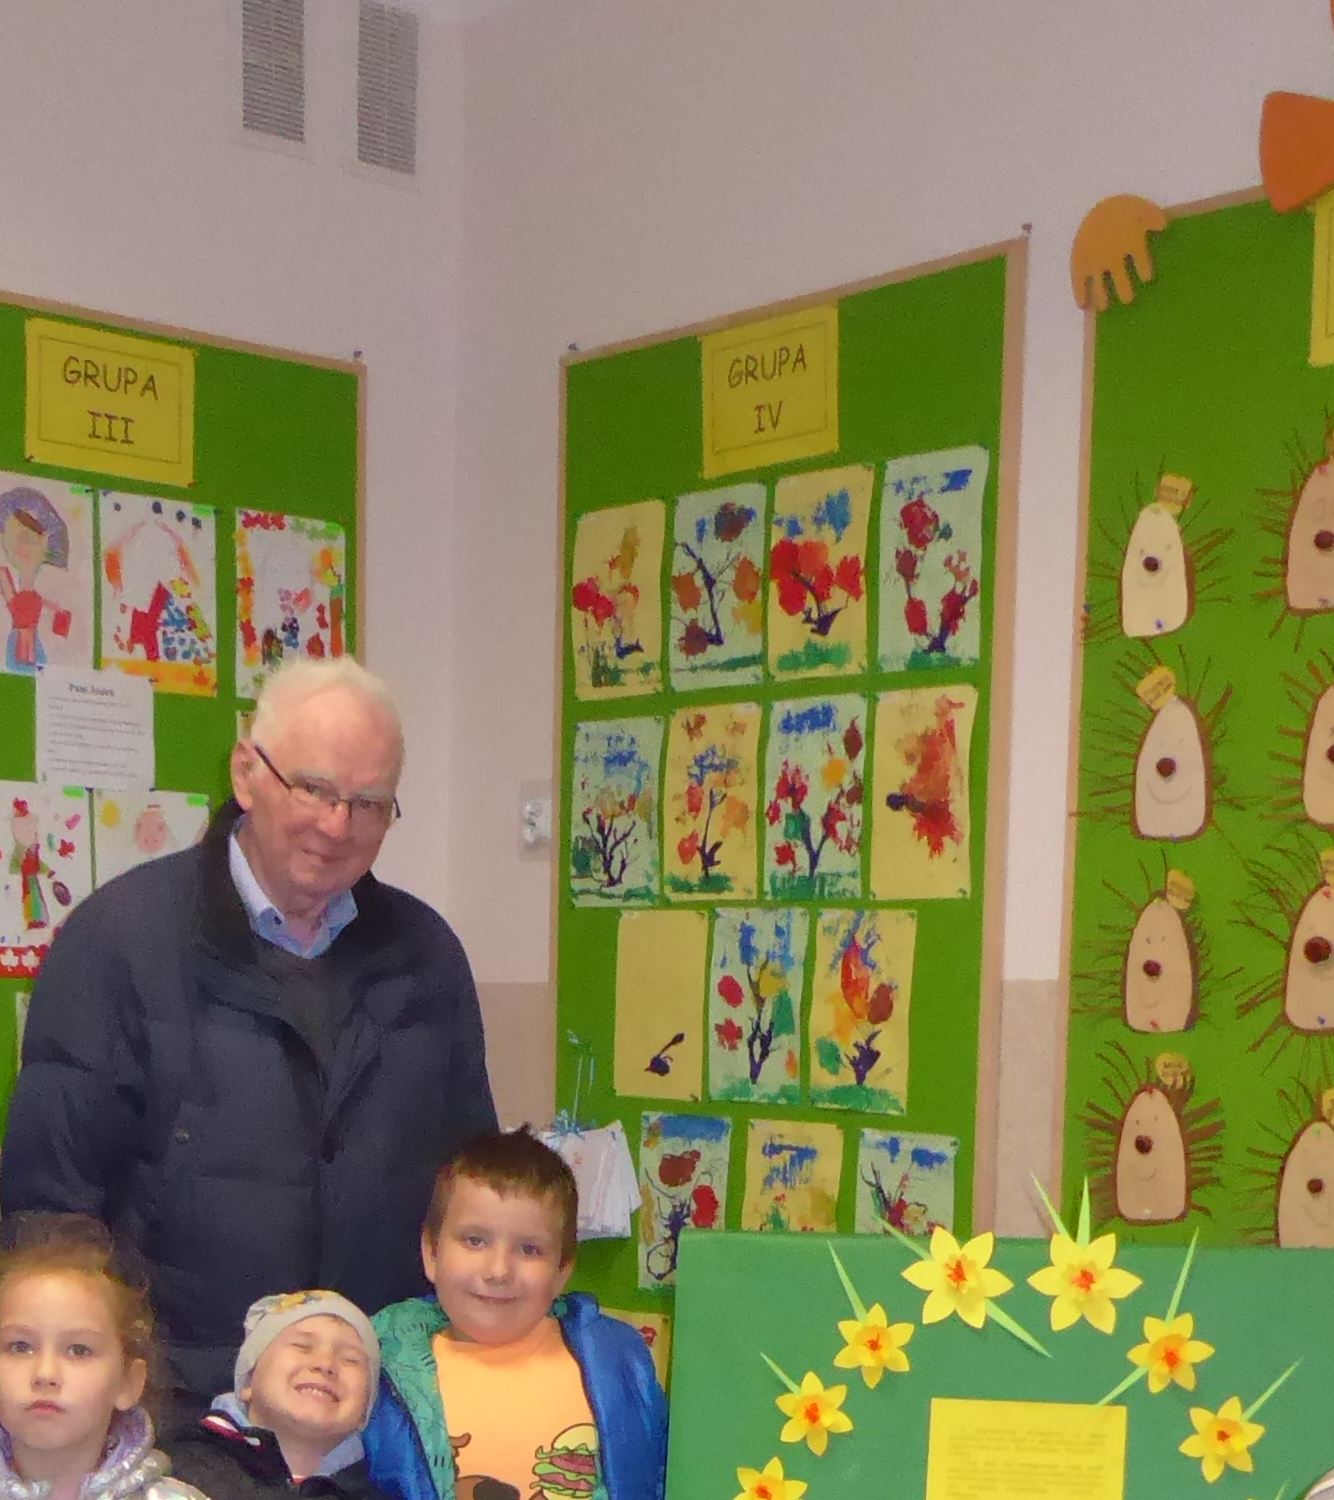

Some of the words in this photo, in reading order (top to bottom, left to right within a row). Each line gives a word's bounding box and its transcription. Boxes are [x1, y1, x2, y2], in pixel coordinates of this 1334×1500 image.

[63, 356, 159, 401] GRUPA
[727, 343, 807, 389] GRUPA
[87, 409, 135, 445] III
[754, 400, 784, 434] IV
